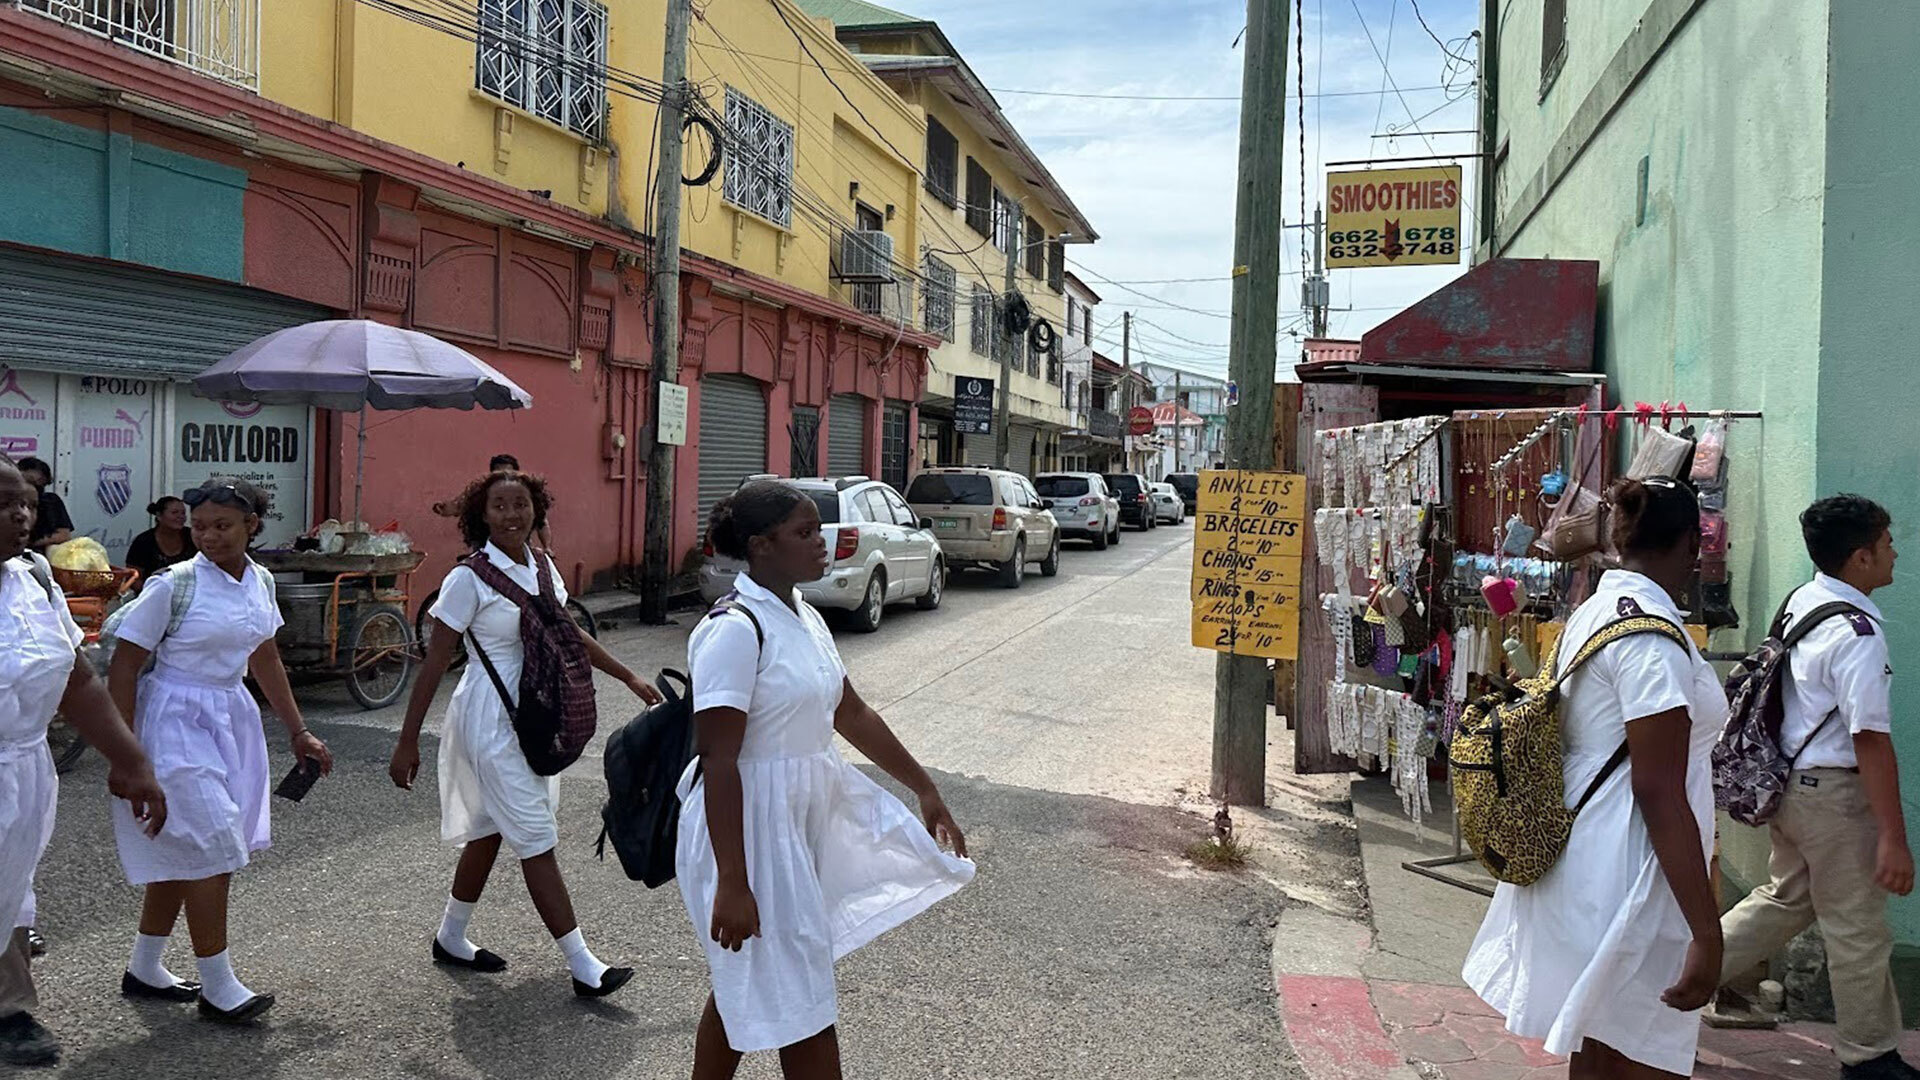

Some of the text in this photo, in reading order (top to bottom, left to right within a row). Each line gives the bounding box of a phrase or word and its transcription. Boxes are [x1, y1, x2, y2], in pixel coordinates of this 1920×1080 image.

[1330, 179, 1457, 214] SMOOTHIES
[1329, 242, 1455, 259] 632-2748
[95, 376, 147, 396] POLO
[81, 426, 133, 448] PUMA
[182, 422, 298, 463] GAYLORD
[267, 472, 274, 480] in
[1208, 476, 1294, 496] ANKLETS
[1230, 496, 1242, 512] 2
[1203, 514, 1299, 537] BRACELETS
[1227, 536, 1239, 552] 2
[1202, 550, 1256, 570] CHAINS
[1225, 569, 1237, 581] 2
[1199, 578, 1242, 598] RINGS
[1211, 600, 1264, 618] HOOPS
